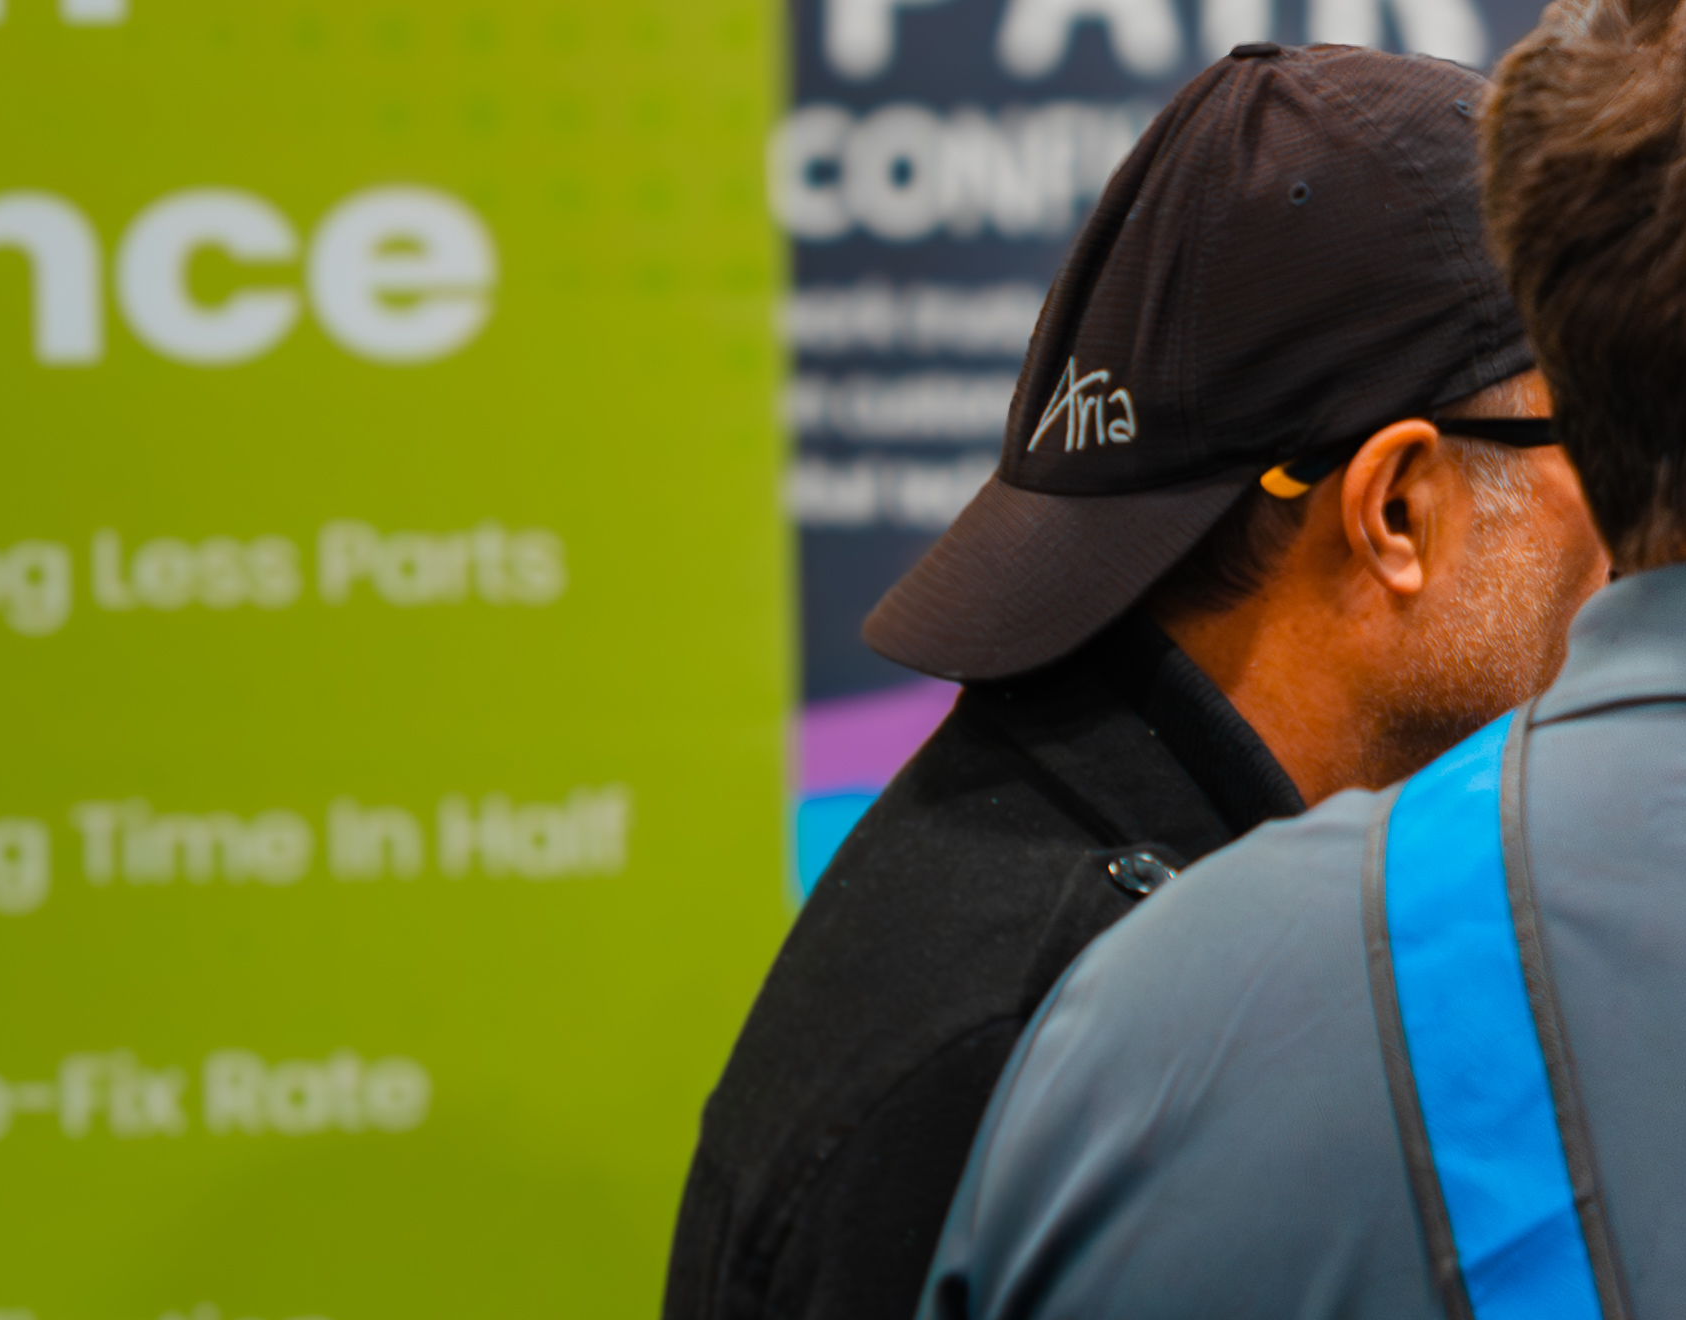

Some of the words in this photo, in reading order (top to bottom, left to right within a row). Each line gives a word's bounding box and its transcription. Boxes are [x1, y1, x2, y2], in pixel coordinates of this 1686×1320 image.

[1025, 356, 1137, 454] Aria
[318, 519, 566, 607] Parts
[71, 797, 311, 886] Time
[438, 784, 631, 880] Half
[203, 1050, 430, 1136] Rate
